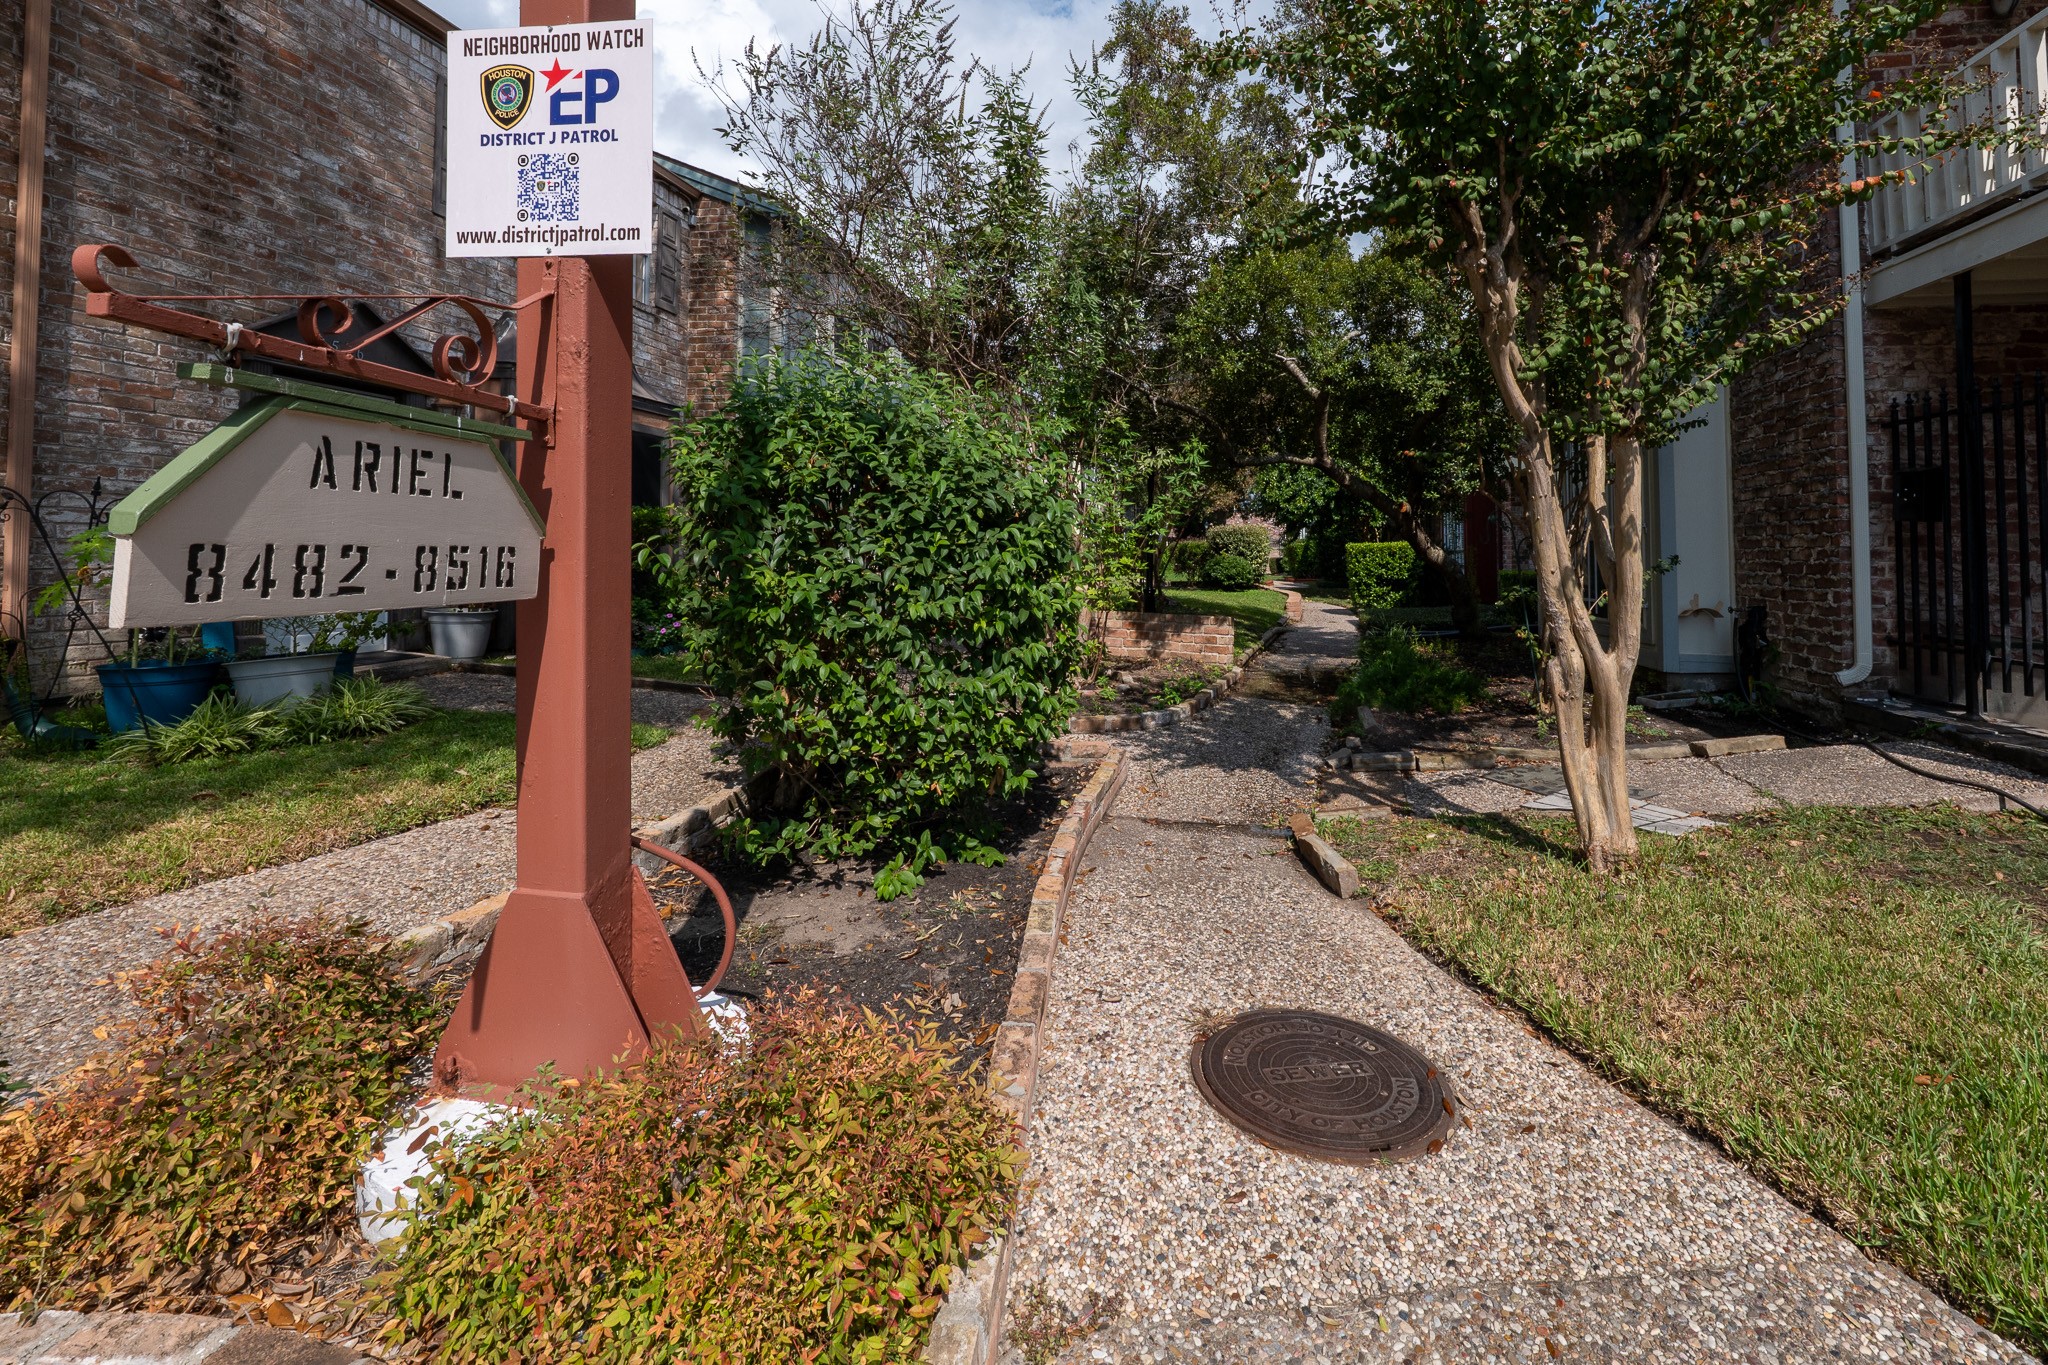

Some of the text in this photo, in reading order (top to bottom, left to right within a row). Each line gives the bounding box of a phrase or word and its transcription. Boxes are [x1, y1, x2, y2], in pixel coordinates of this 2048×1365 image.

[463, 28, 644, 57] NEIGHBORHOOD WATCH
[488, 69, 527, 81] HOUSTON
[495, 108, 520, 119] POLICE
[480, 129, 619, 147] DISTRICT J PATROL
[456, 223, 641, 247] www.districtjpatrol.com
[309, 434, 464, 500] ARIEL
[1269, 1062, 1373, 1081] SEWER
[1250, 1079, 1415, 1131] CITY OF HOUSTON
